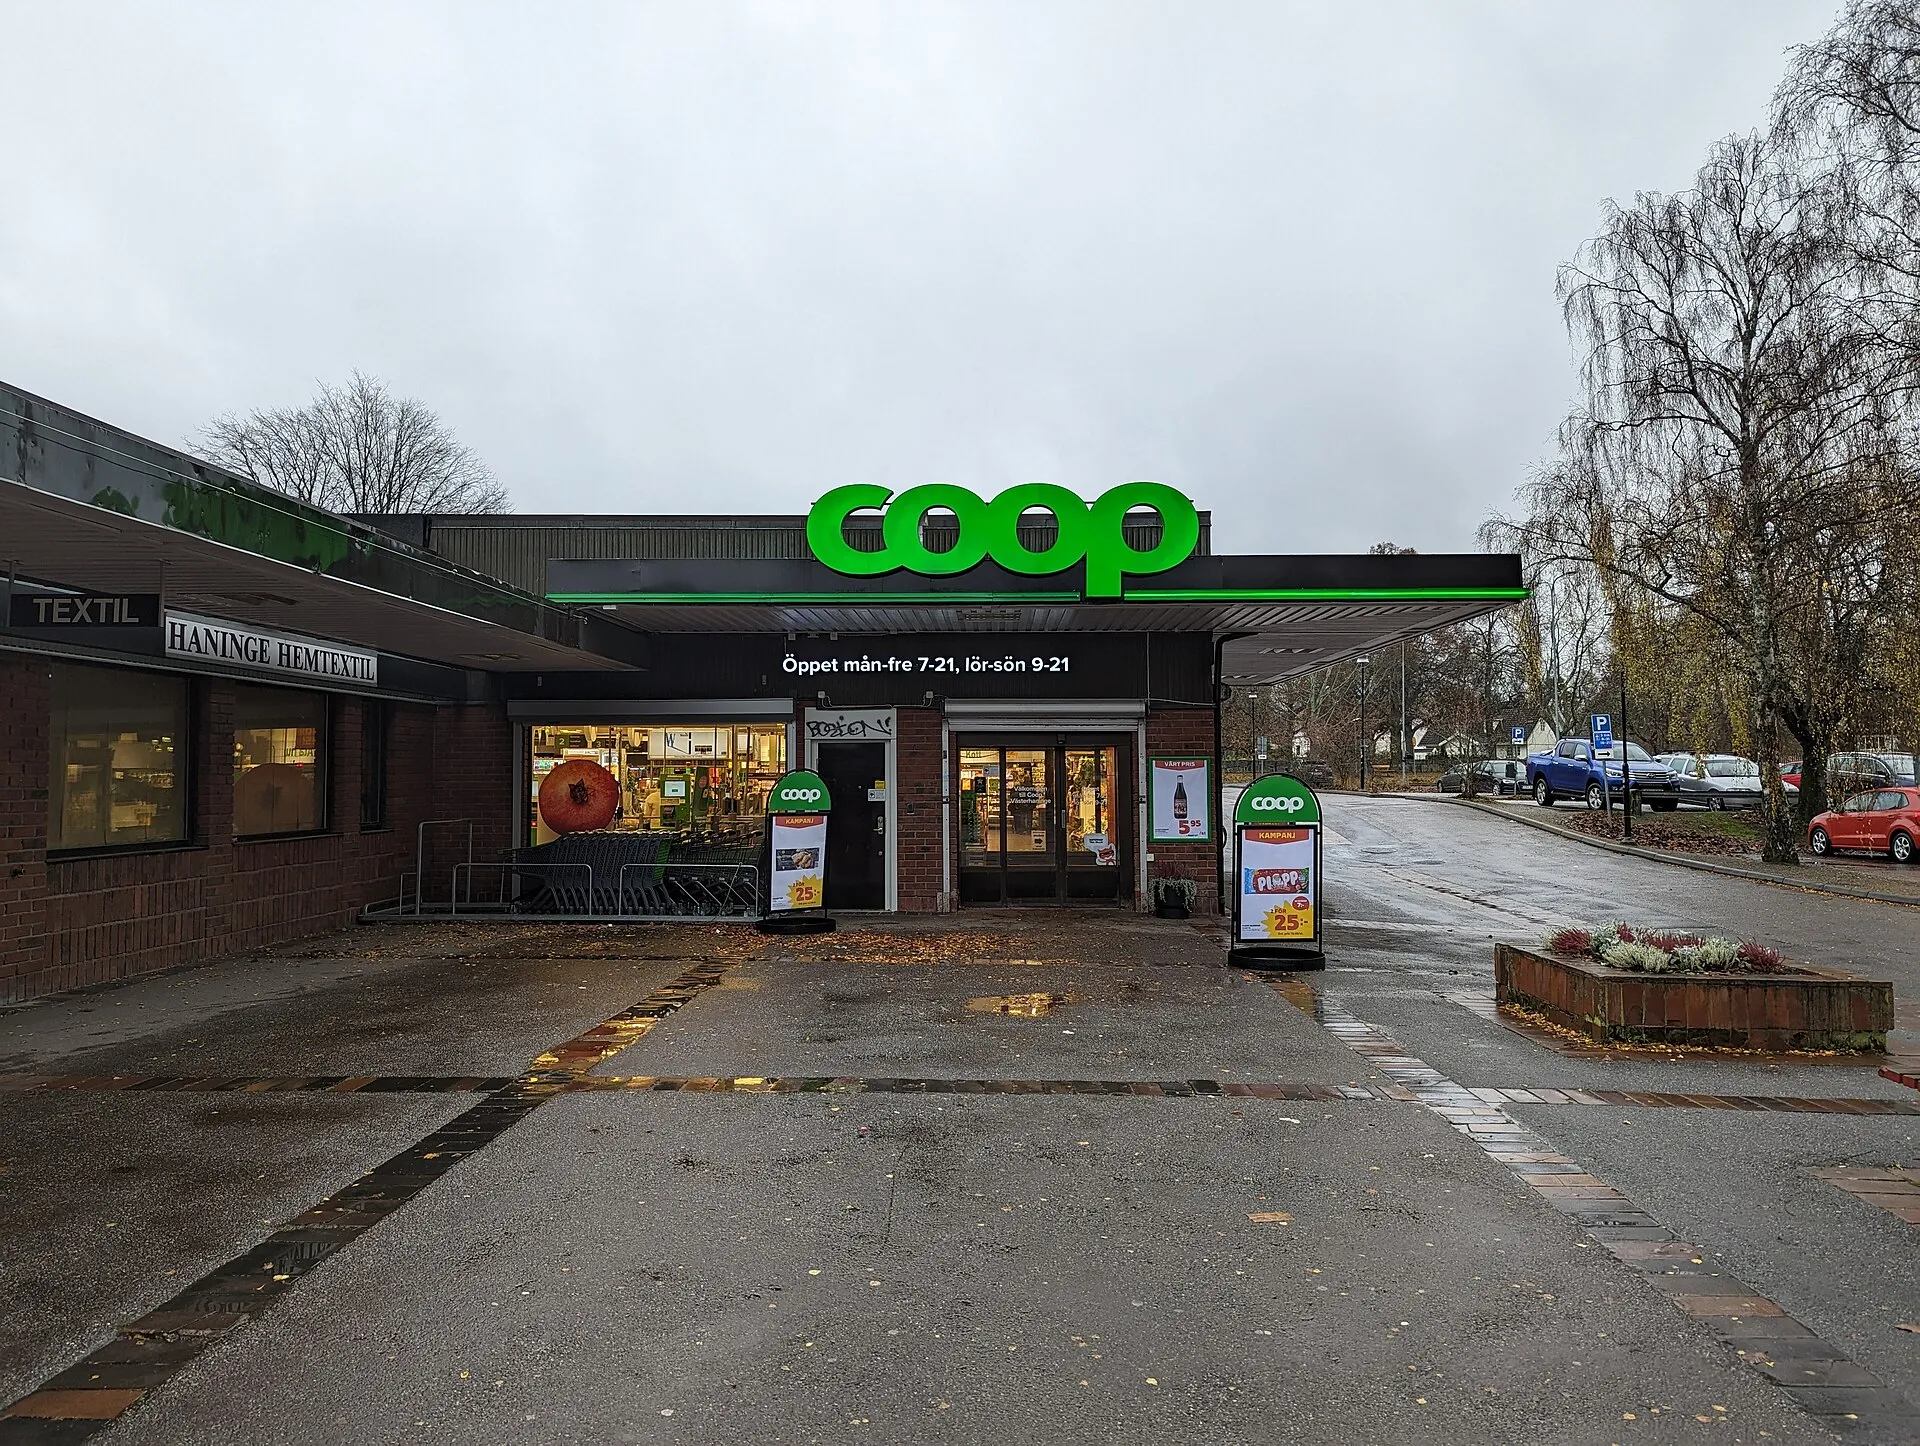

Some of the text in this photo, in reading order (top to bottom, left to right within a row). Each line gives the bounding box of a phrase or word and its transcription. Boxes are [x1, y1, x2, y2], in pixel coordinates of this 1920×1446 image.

[806, 482, 1199, 598] coop
[33, 598, 139, 623] TEXTIL
[168, 621, 375, 681] HANINGE HEMTEXTIL
[783, 653, 1069, 676] Öppet mån-fre 7-21, lör-sön 9-21
[1514, 728, 1522, 738] P
[1596, 716, 1607, 731] P
[781, 788, 821, 803] coop
[1251, 797, 1304, 814] coop
